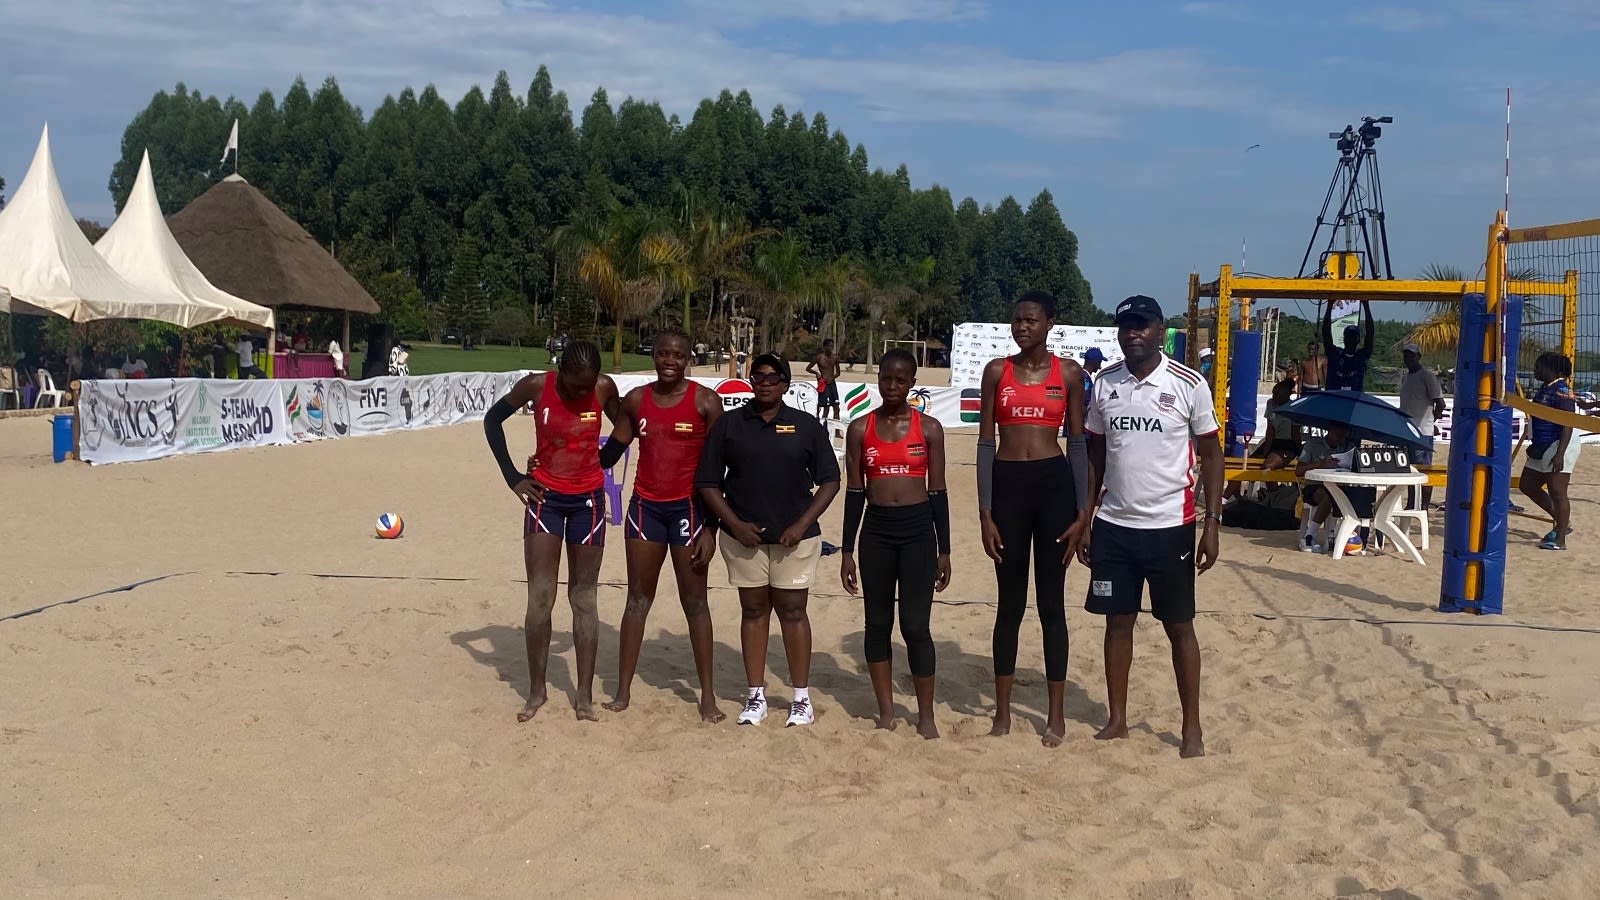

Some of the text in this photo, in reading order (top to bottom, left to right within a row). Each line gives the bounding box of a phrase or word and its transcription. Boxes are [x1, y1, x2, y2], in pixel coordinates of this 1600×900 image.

[221, 397, 256, 420] S-TEAM
[1002, 395, 1008, 407] 1
[543, 407, 549, 424] 1
[1011, 406, 1045, 417] KEN
[639, 418, 647, 436] 2
[1109, 416, 1163, 433] KENYA
[866, 456, 875, 467] 2
[1361, 453, 1370, 466] 0
[1398, 453, 1407, 467] 0
[880, 464, 910, 474] KEN
[679, 519, 690, 537] 2
